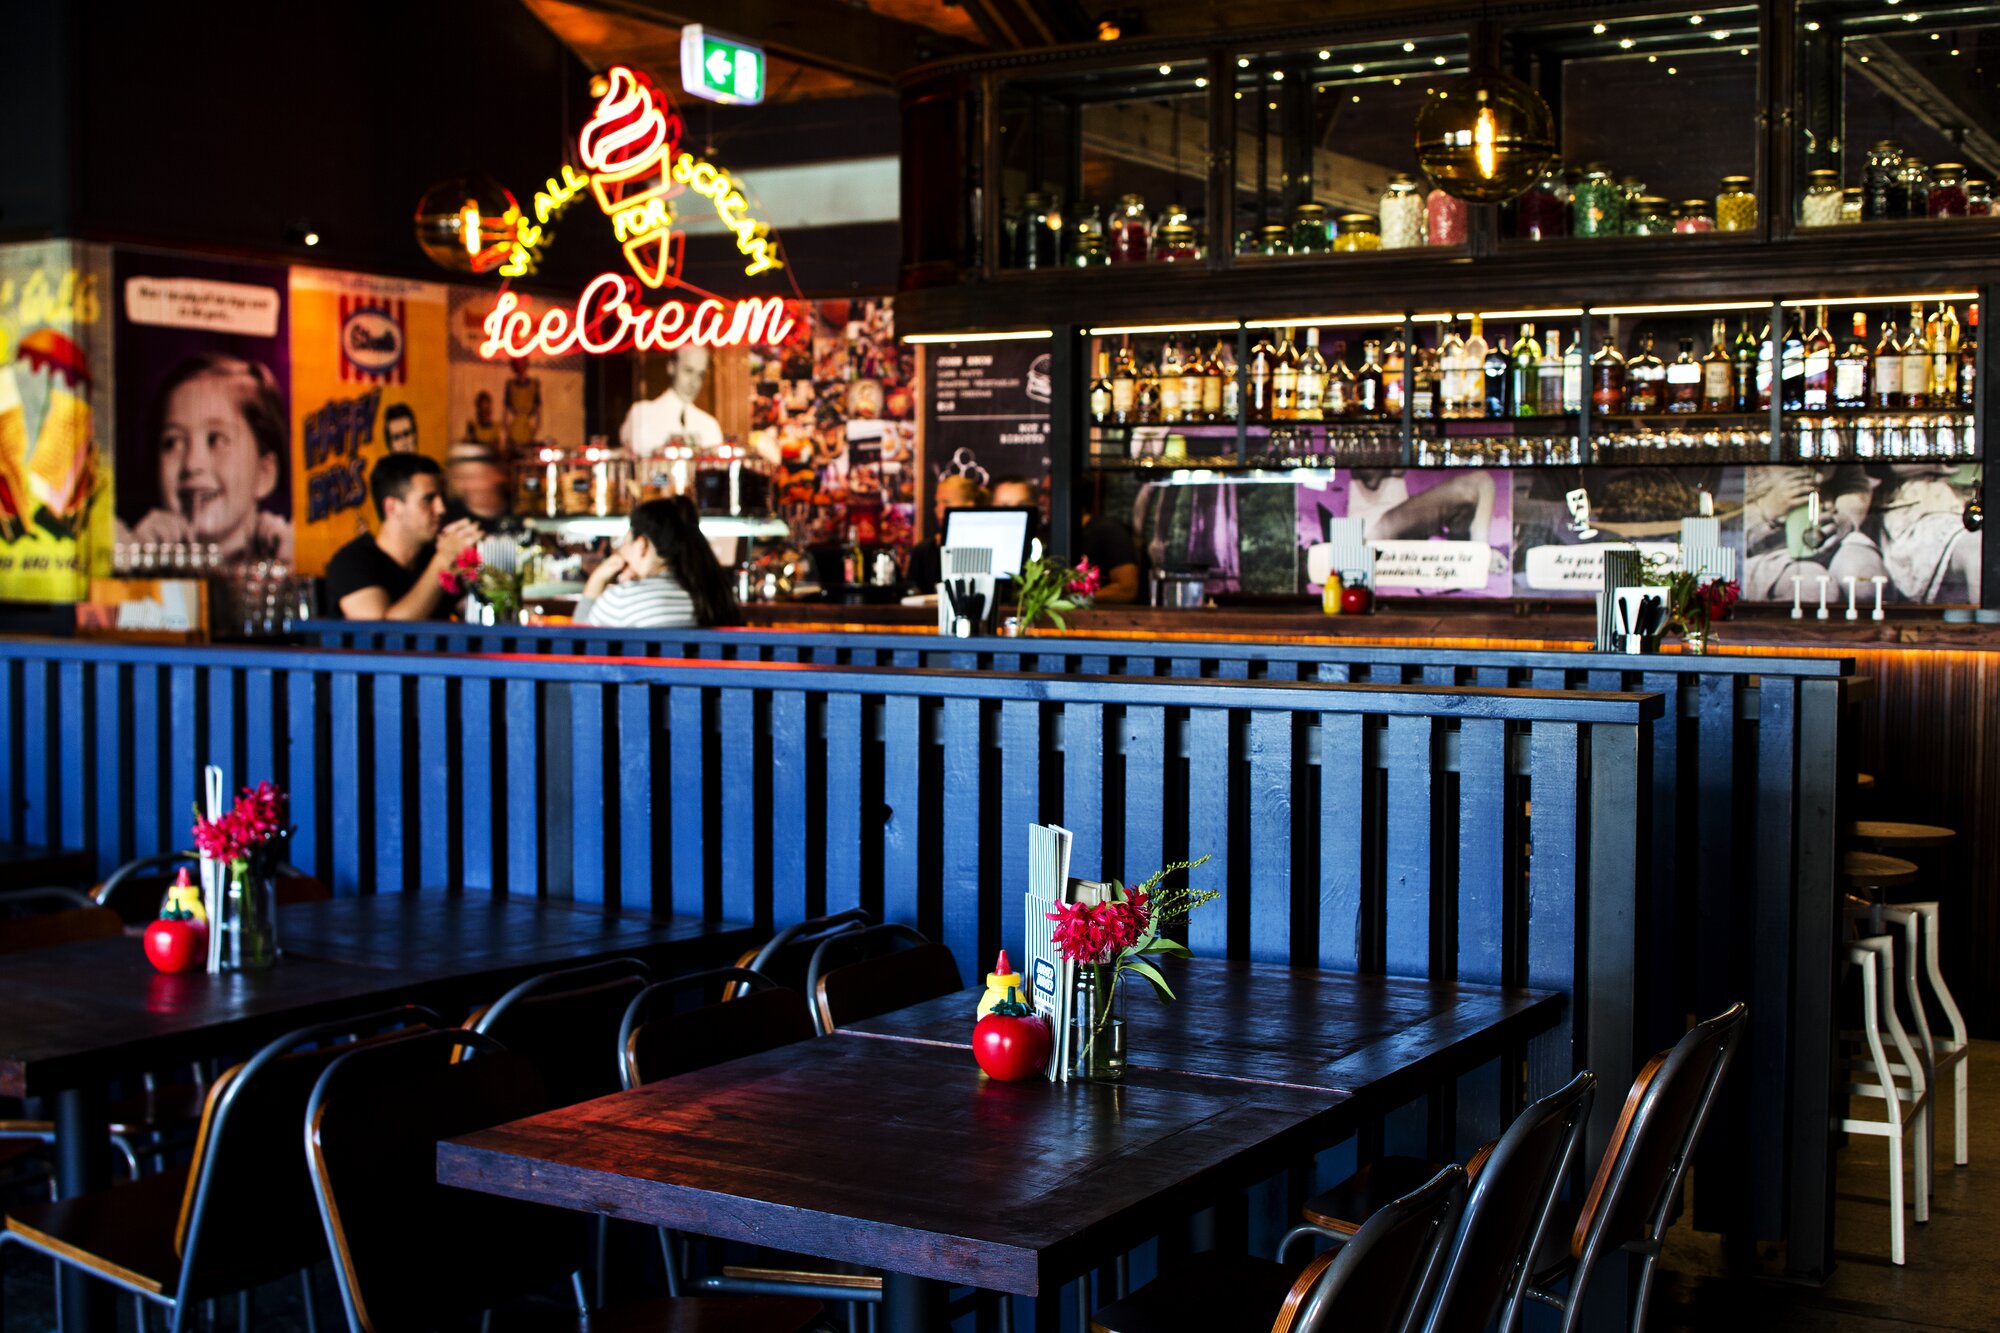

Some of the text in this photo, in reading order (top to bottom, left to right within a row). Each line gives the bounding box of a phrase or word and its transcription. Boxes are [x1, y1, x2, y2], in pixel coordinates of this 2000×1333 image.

[498, 165, 589, 276] WE ALL
[612, 197, 672, 242] FOR
[673, 153, 774, 276] SCREAM
